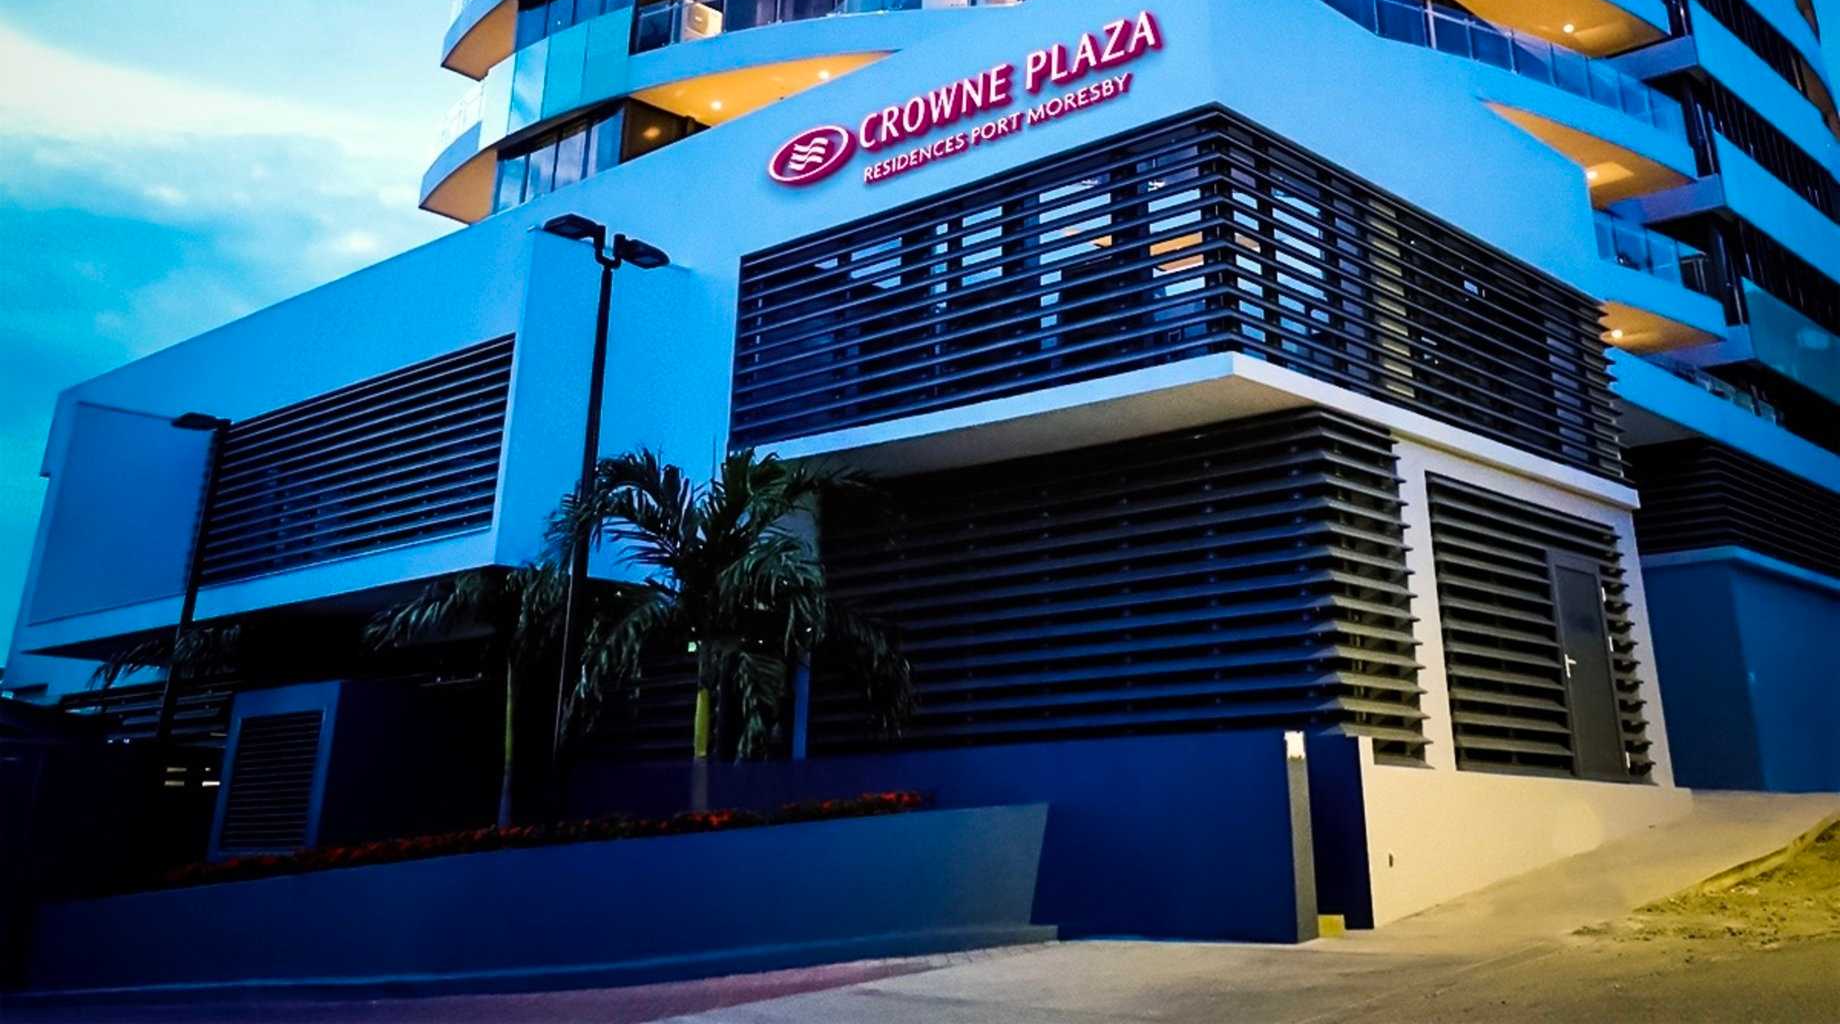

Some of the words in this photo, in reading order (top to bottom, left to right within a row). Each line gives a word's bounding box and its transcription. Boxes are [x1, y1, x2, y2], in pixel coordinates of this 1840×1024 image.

[858, 63, 1010, 149] CROWNE
[1025, 10, 1161, 92] PLAZA
[863, 135, 966, 183] RESIDENCES
[971, 112, 1021, 142] PORT
[1026, 72, 1131, 126] MORESBY
